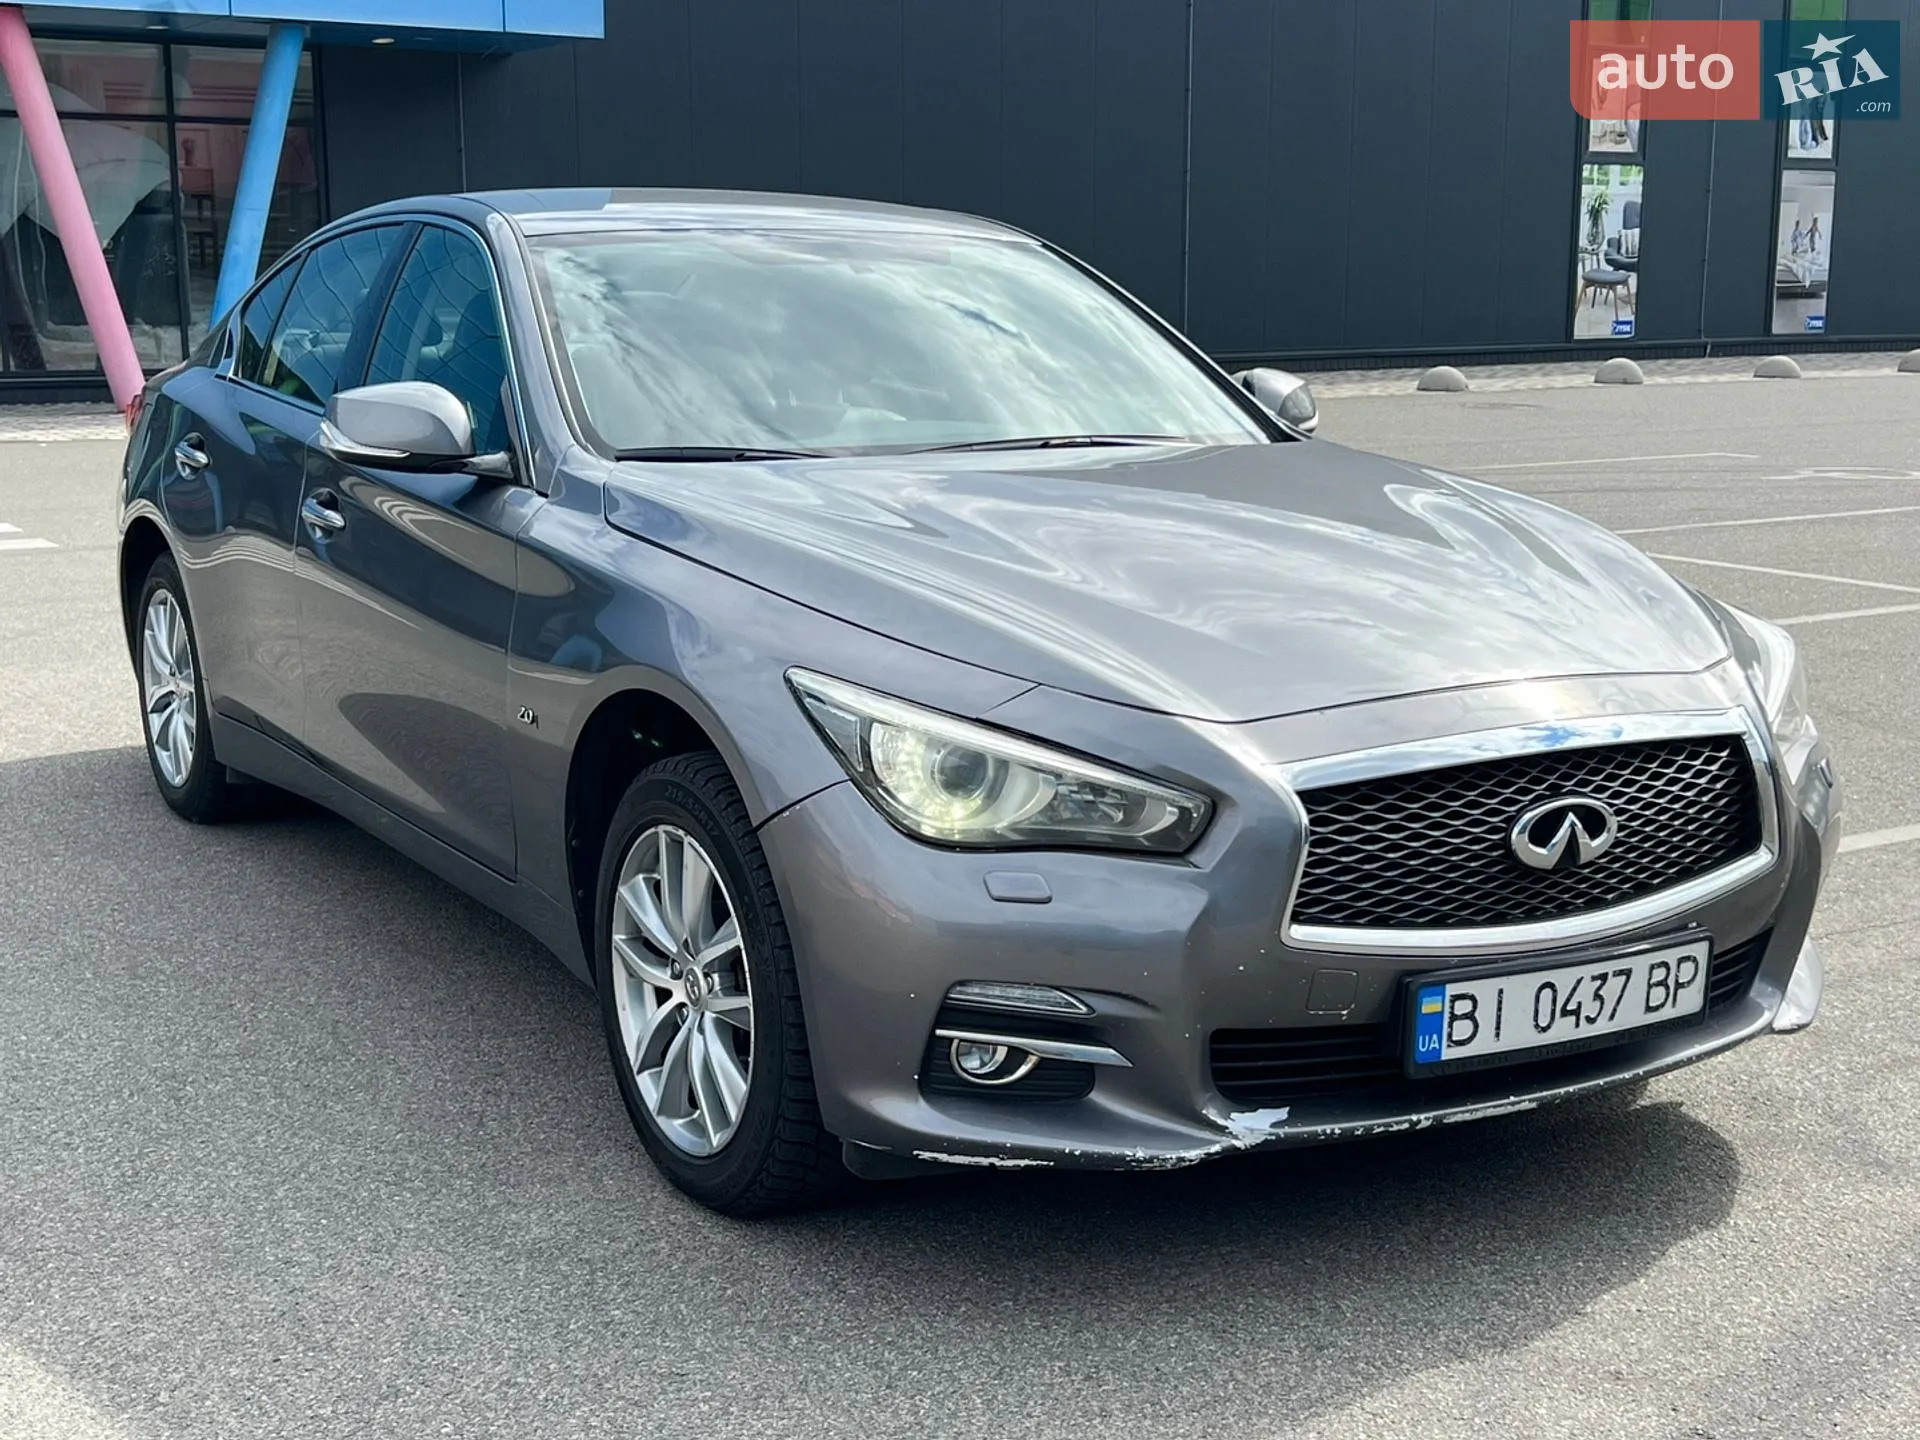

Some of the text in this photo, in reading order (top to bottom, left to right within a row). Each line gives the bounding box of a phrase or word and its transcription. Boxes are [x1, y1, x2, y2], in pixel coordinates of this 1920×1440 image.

[1448, 988, 1504, 1048] BI
[1533, 968, 1633, 1034] 0437
[1644, 954, 1699, 1015] BP
[1418, 1033, 1440, 1052] UA
